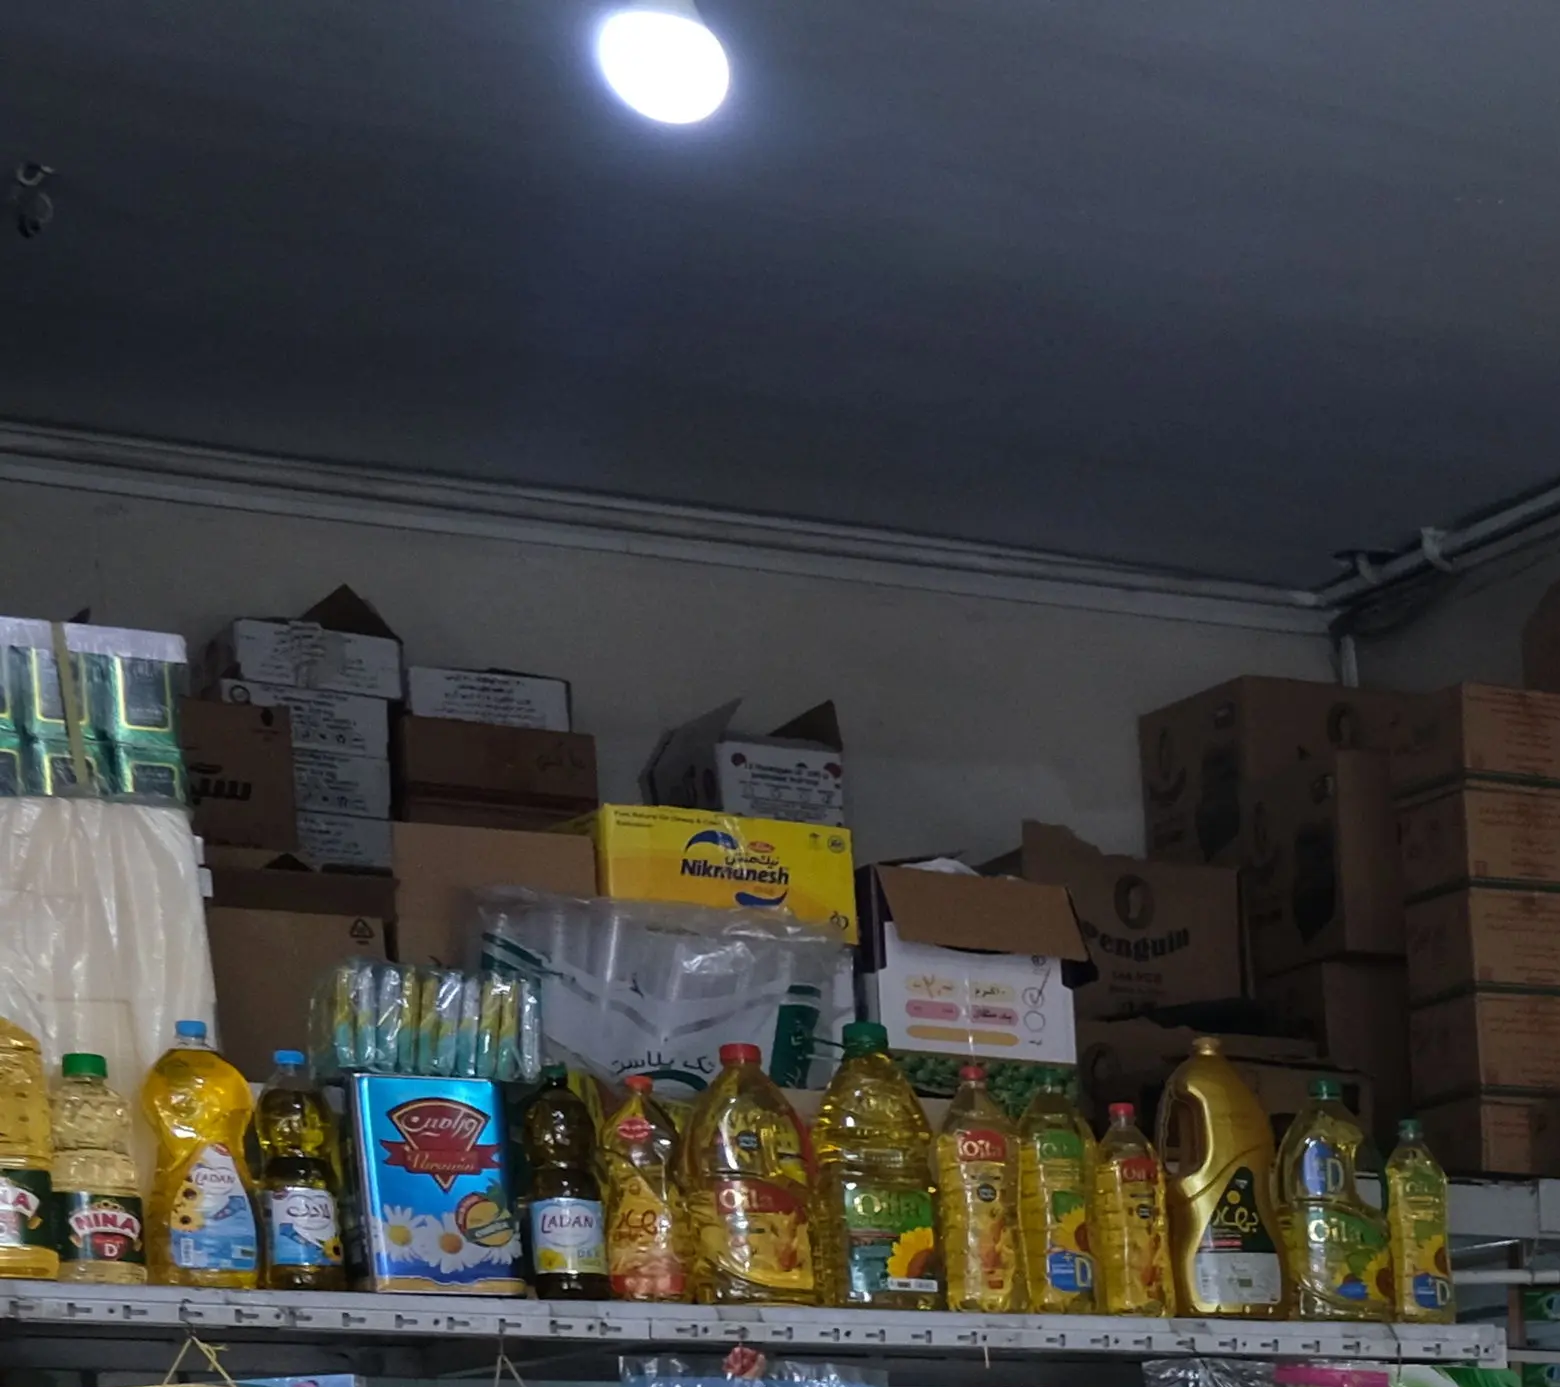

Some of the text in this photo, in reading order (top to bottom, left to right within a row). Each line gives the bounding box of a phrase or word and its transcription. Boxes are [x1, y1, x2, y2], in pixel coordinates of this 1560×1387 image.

[681, 857, 790, 886] Nikmanesh
[195, 1170, 238, 1187] LADAN
[75, 1210, 138, 1234] NINA
[541, 1213, 594, 1234] LADAN
